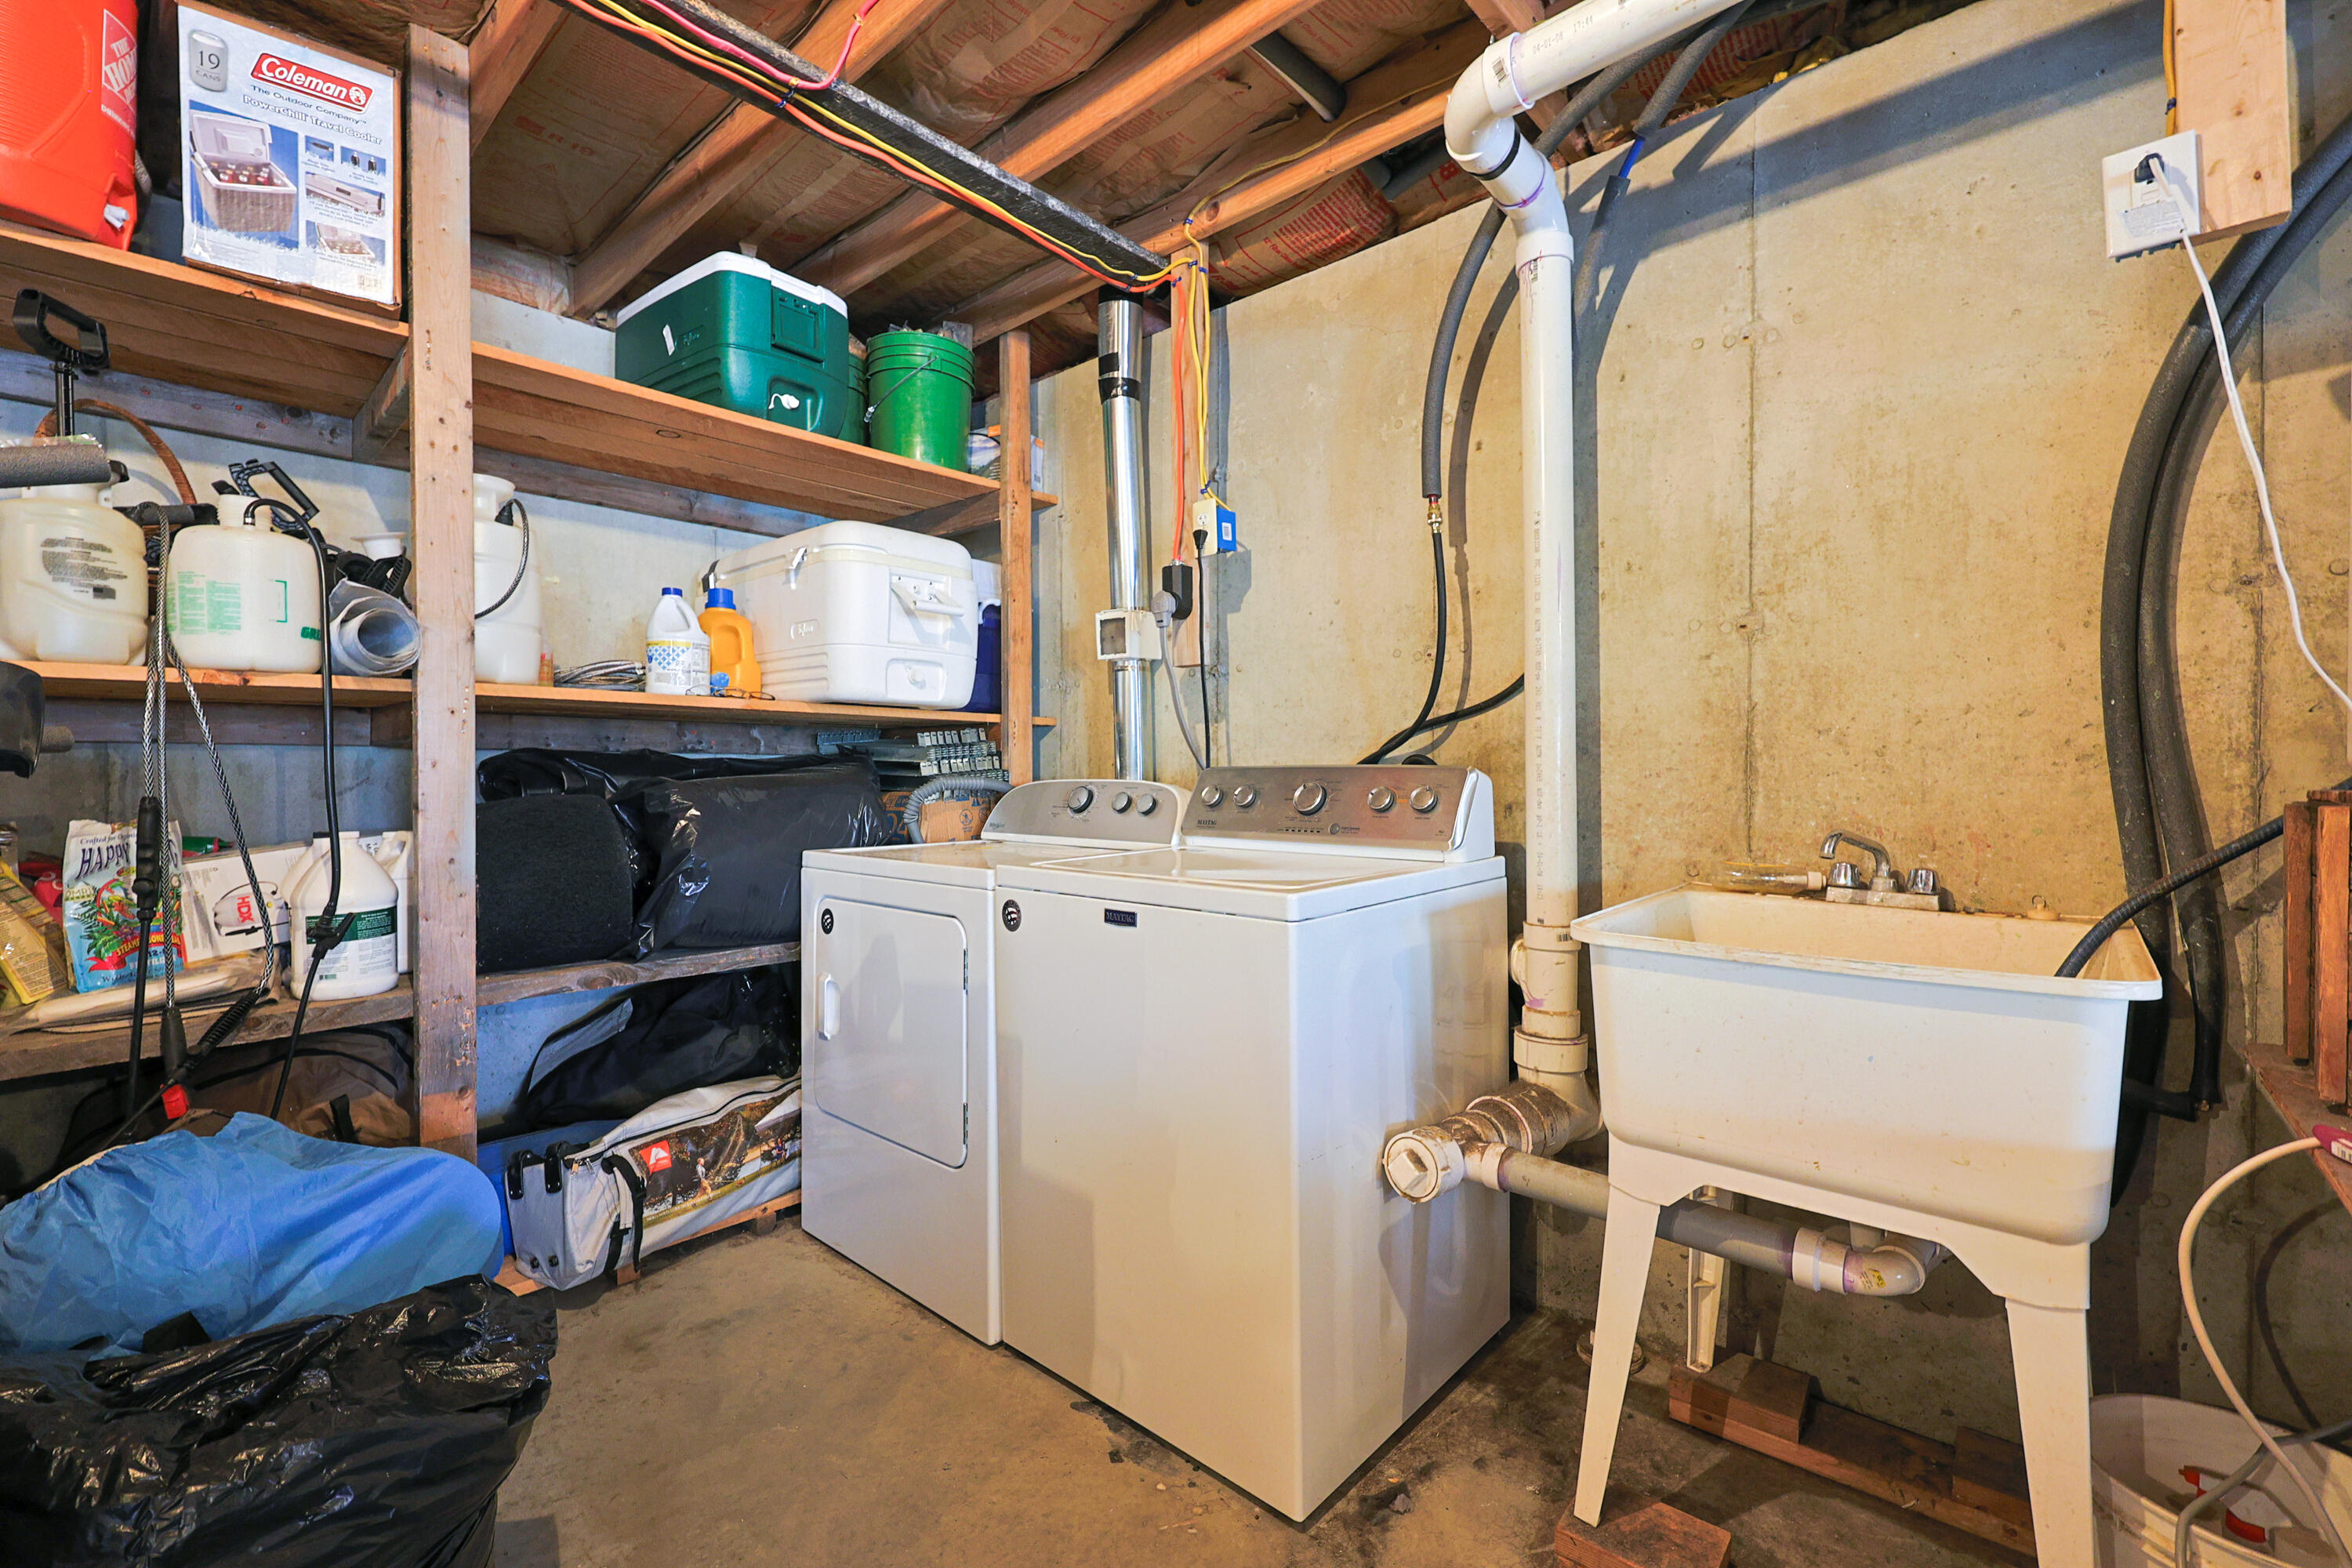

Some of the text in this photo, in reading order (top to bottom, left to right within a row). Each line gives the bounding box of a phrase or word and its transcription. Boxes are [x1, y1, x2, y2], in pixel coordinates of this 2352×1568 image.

[111, 37, 130, 58] THE
[198, 50, 220, 70] 19
[103, 48, 136, 93] HOM
[195, 70, 221, 82] CANS
[261, 56, 349, 101] Coleman
[251, 84, 270, 96] The
[274, 91, 313, 109] Outdoor
[310, 114, 344, 133] Travel
[346, 127, 382, 146] Cooler
[80, 833, 137, 845] Crafted for Organi
[75, 841, 131, 880] HAPPY
[237, 895, 254, 924] HDX
[1106, 911, 1135, 923] MAYTAG
